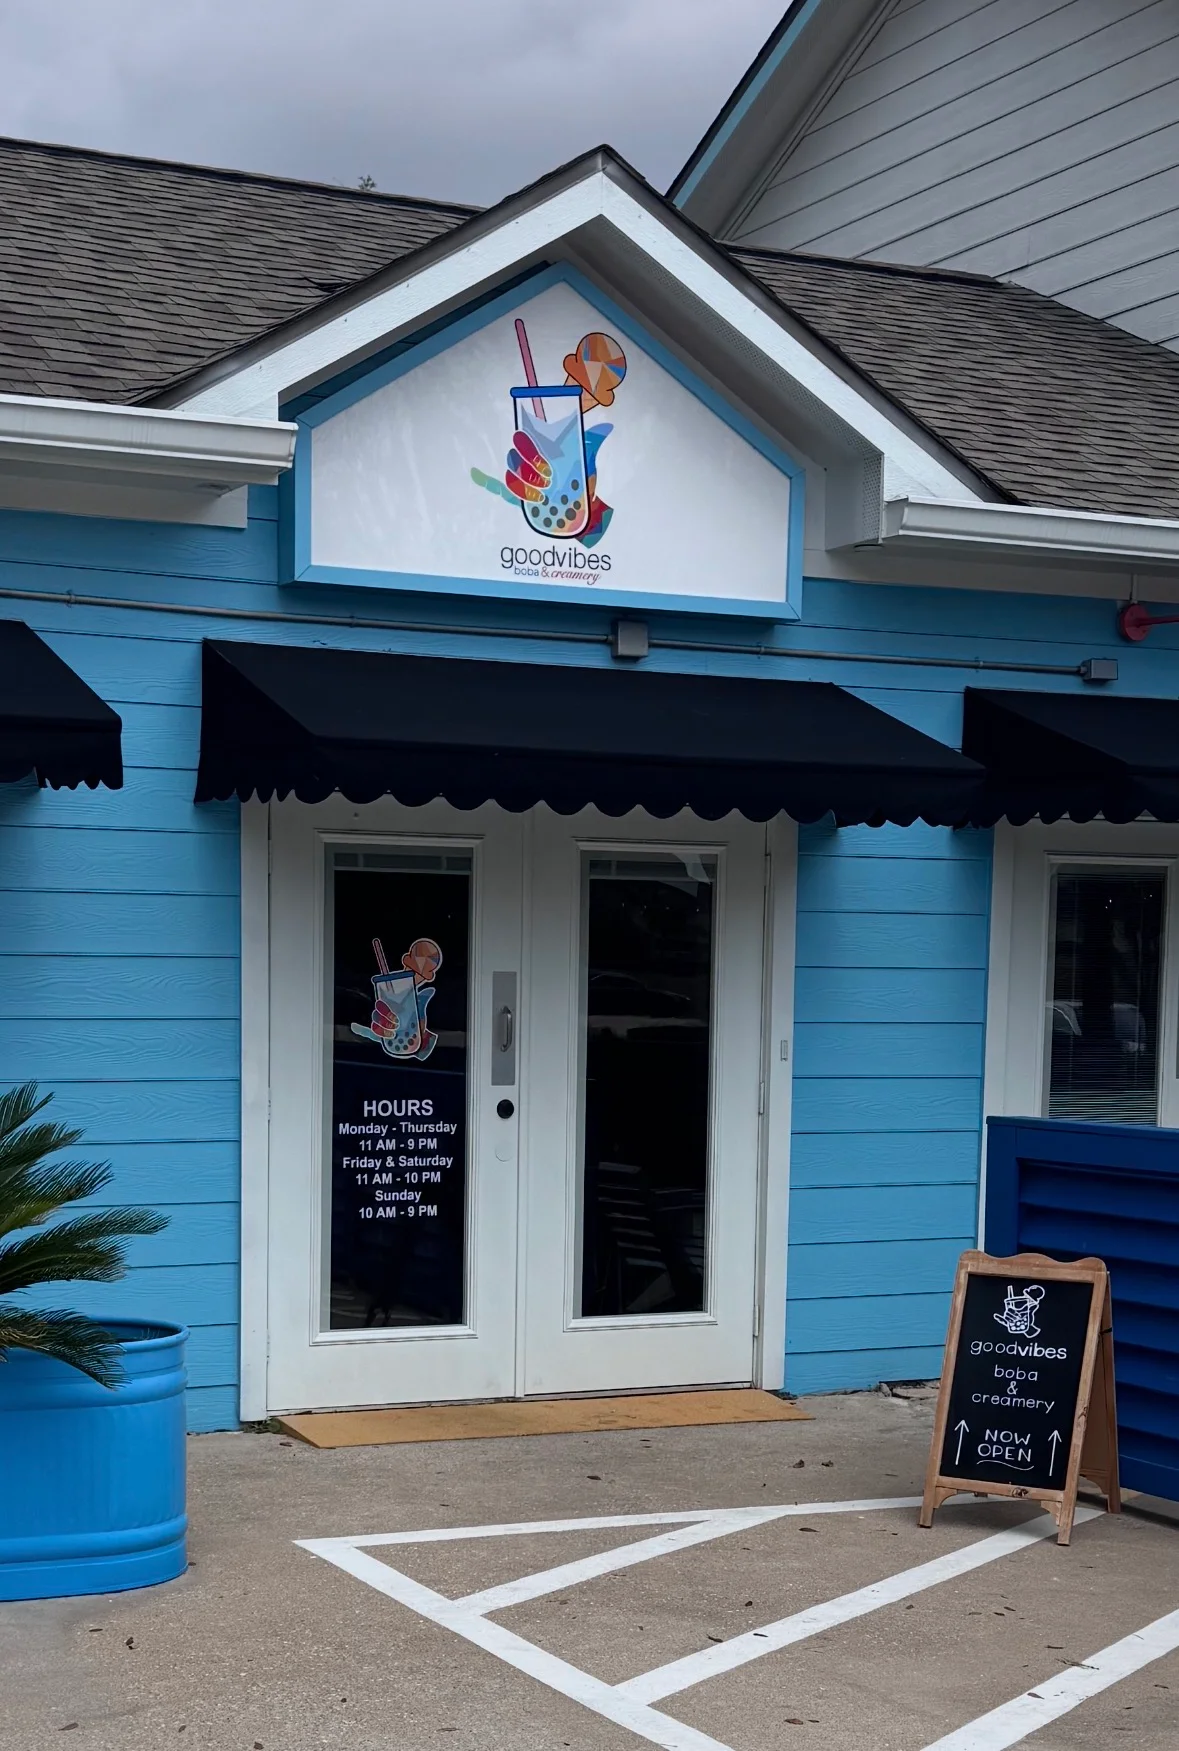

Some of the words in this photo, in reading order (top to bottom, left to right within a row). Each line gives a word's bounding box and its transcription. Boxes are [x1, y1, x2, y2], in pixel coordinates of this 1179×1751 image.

[500, 545, 612, 571] goodvibes
[514, 566, 539, 576] boba
[541, 566, 550, 578] &
[551, 569, 601, 585] creamery
[363, 1099, 434, 1117] HOURS
[338, 1122, 388, 1136] Monday
[400, 1121, 457, 1135] Thursday
[359, 1139, 372, 1151] 11
[376, 1139, 396, 1150] AM
[407, 1138, 415, 1150] 9
[418, 1138, 437, 1150] PM
[342, 1156, 382, 1170] Friday
[385, 1156, 395, 1167] &
[398, 1155, 453, 1168] Saturday
[355, 1173, 368, 1185] 11
[372, 1173, 393, 1184] AM
[404, 1172, 418, 1184] 10
[422, 1171, 441, 1183] PM
[375, 1189, 422, 1203] Sunday
[359, 1207, 373, 1219] 10
[376, 1206, 396, 1218] AM
[407, 1205, 415, 1217] 9
[418, 1204, 438, 1217] PM
[970, 1340, 1067, 1359] goodvibes
[994, 1364, 1038, 1381] boba
[1006, 1380, 1018, 1395] &
[971, 1393, 1055, 1414] creamery
[985, 1428, 1031, 1445] NOW
[977, 1443, 1032, 1462] OPEN
